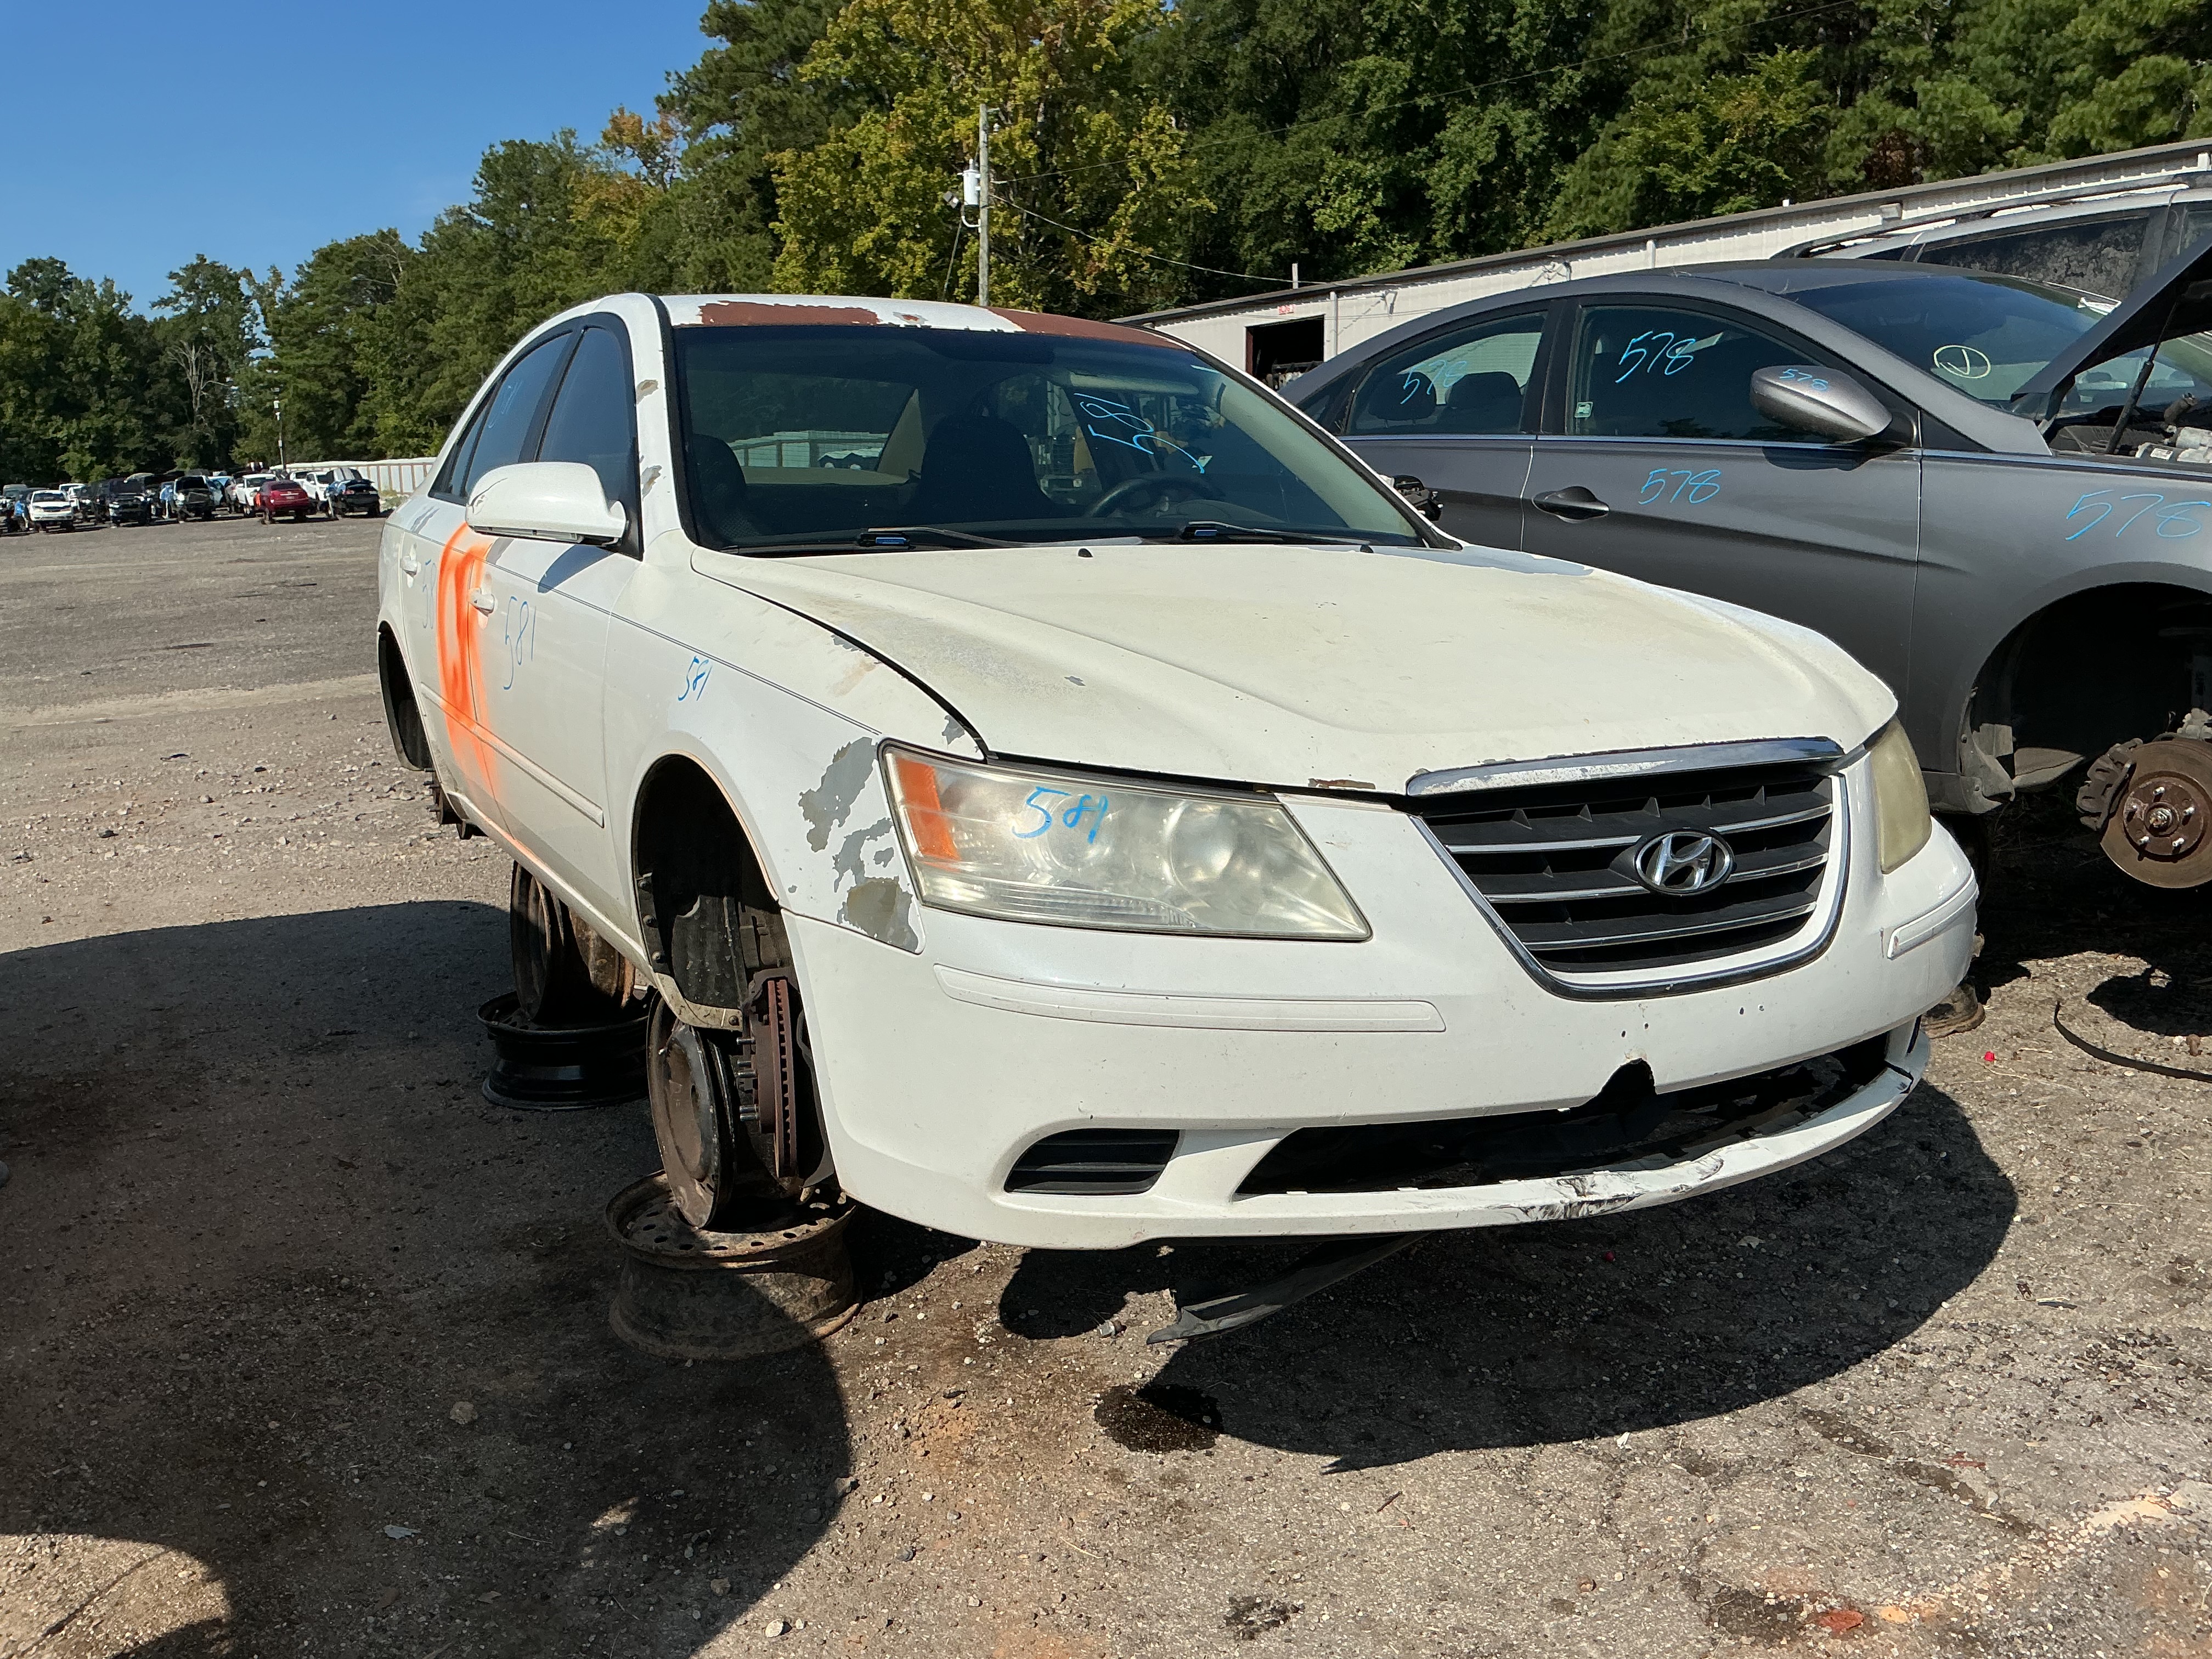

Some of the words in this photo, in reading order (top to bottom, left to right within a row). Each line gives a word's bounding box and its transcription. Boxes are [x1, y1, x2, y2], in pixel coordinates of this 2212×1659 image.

[1615, 331, 1696, 383] 578
[1781, 368, 1829, 391] 578
[1400, 359, 1468, 405] 578
[1638, 468, 1722, 505] 578
[2065, 489, 2211, 541] 578
[503, 596, 537, 690] 581
[677, 655, 713, 702] 581
[1011, 786, 1108, 844] 581
